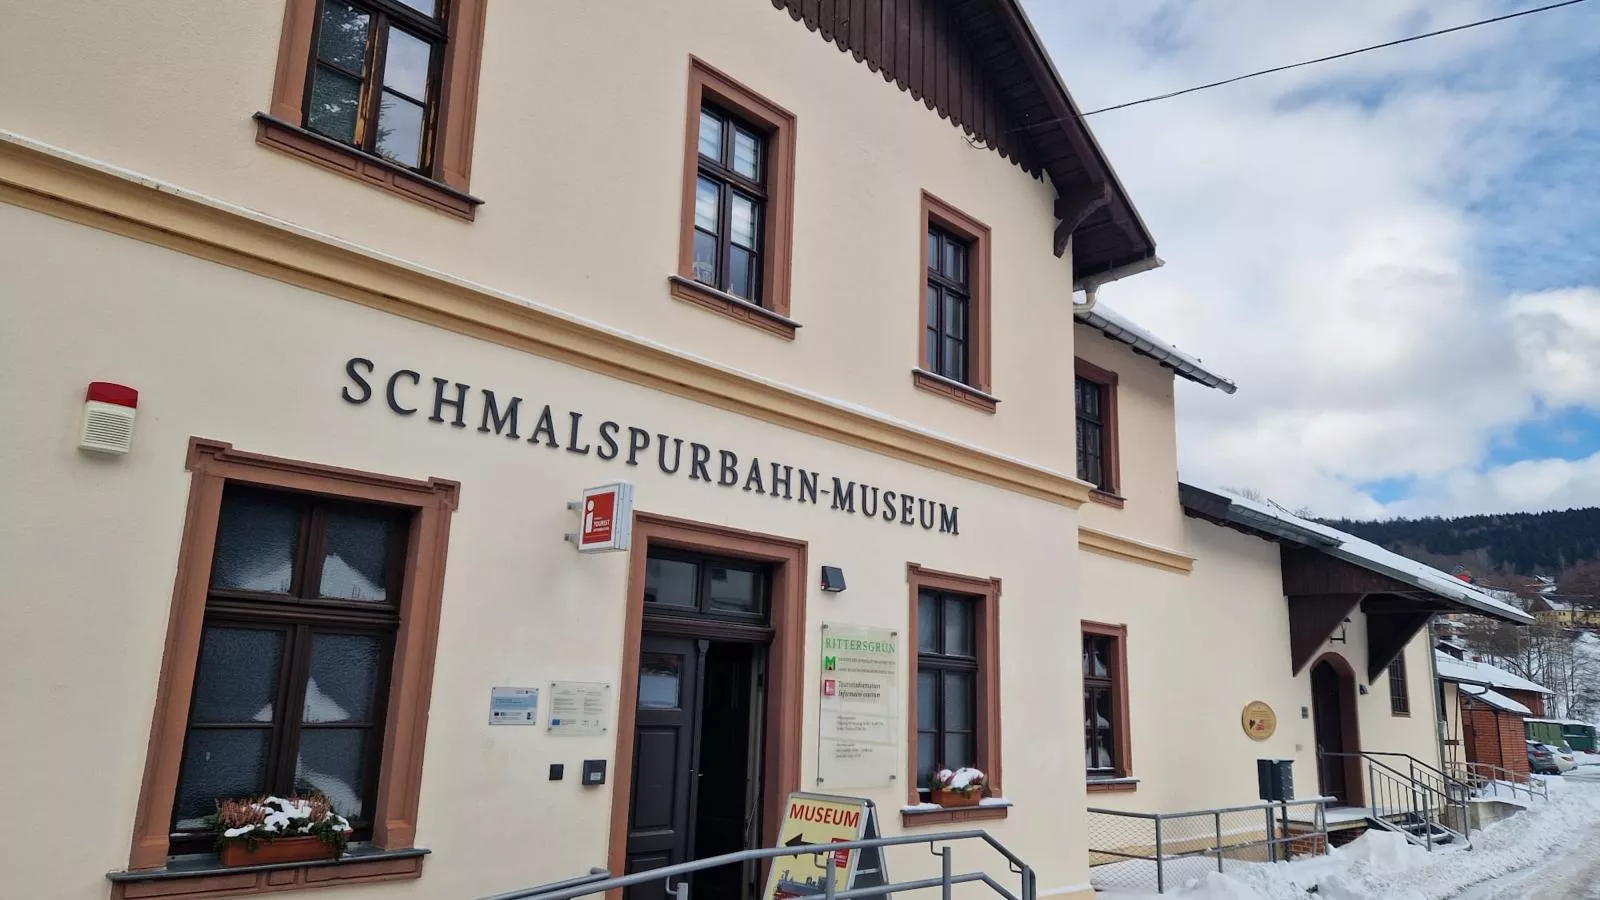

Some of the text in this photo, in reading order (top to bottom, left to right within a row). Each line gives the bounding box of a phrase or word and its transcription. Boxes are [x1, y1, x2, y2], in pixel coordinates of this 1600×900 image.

[341, 356, 960, 536] SCHMALSPURBAHN-MUSEUM
[825, 638, 895, 653] RITTERSGRÜN
[790, 803, 860, 828] MUSEUM
